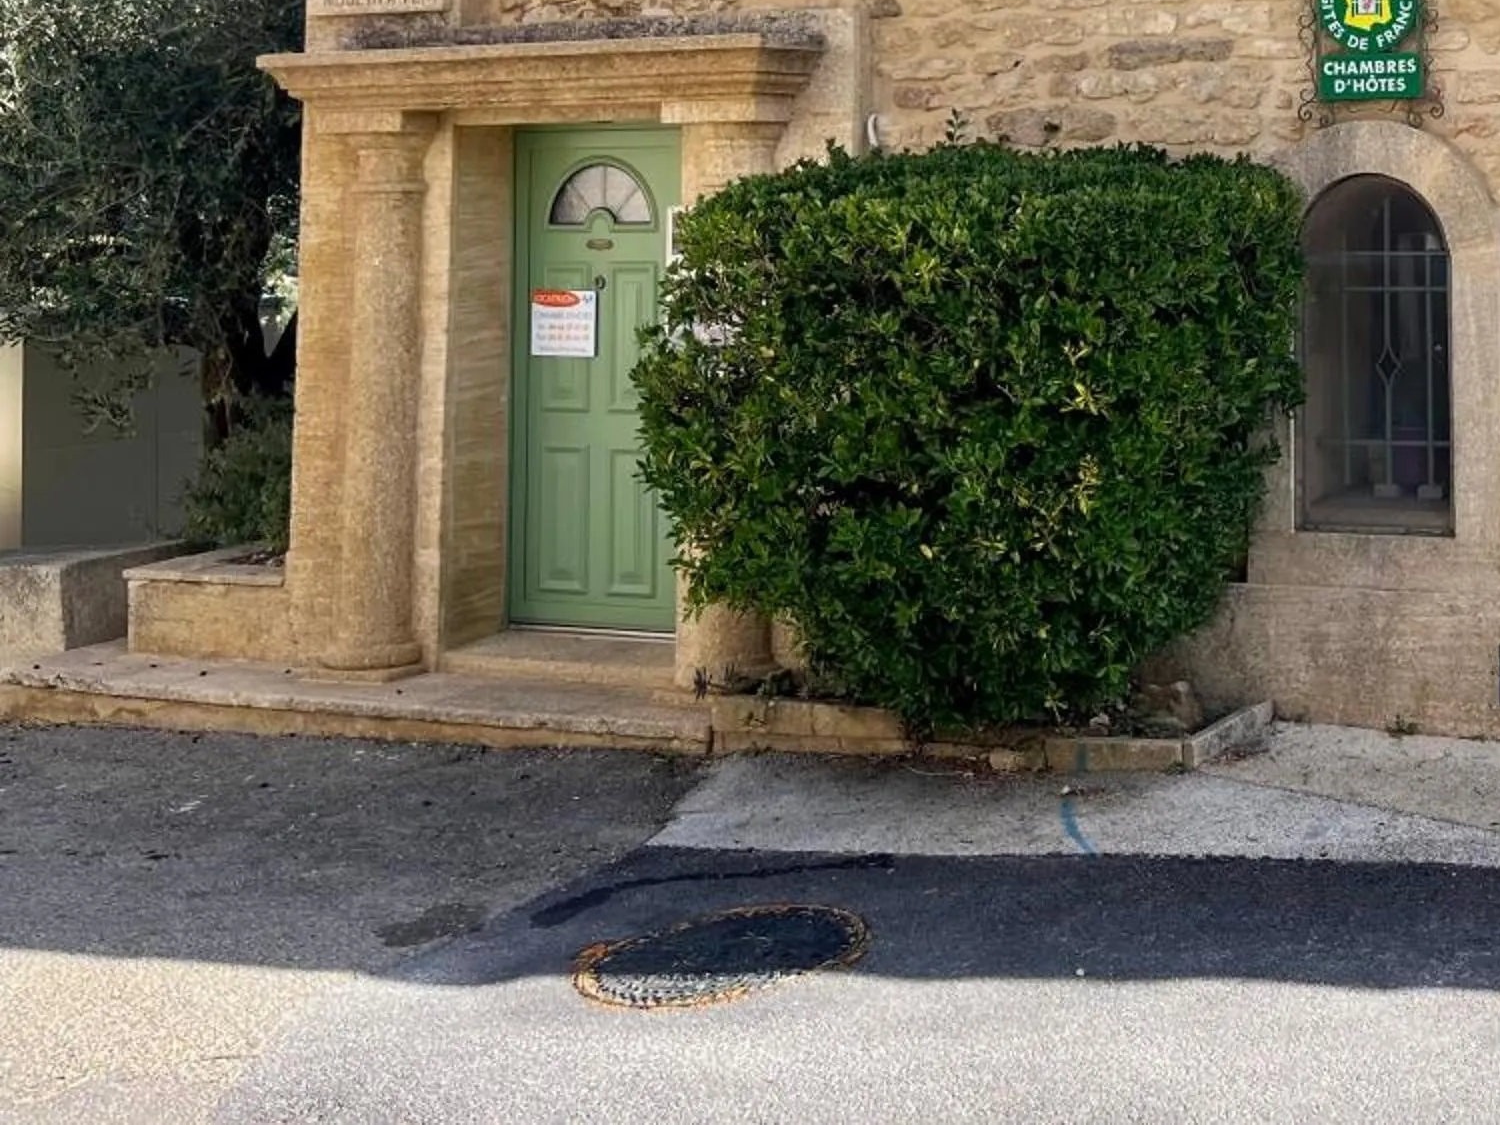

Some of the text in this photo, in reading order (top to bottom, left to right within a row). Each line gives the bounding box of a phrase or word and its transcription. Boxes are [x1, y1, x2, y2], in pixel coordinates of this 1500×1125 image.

[1347, 34, 1369, 50] DE
[1323, 57, 1417, 76] CHAMBRES
[1334, 74, 1407, 93] D'HÔTES
